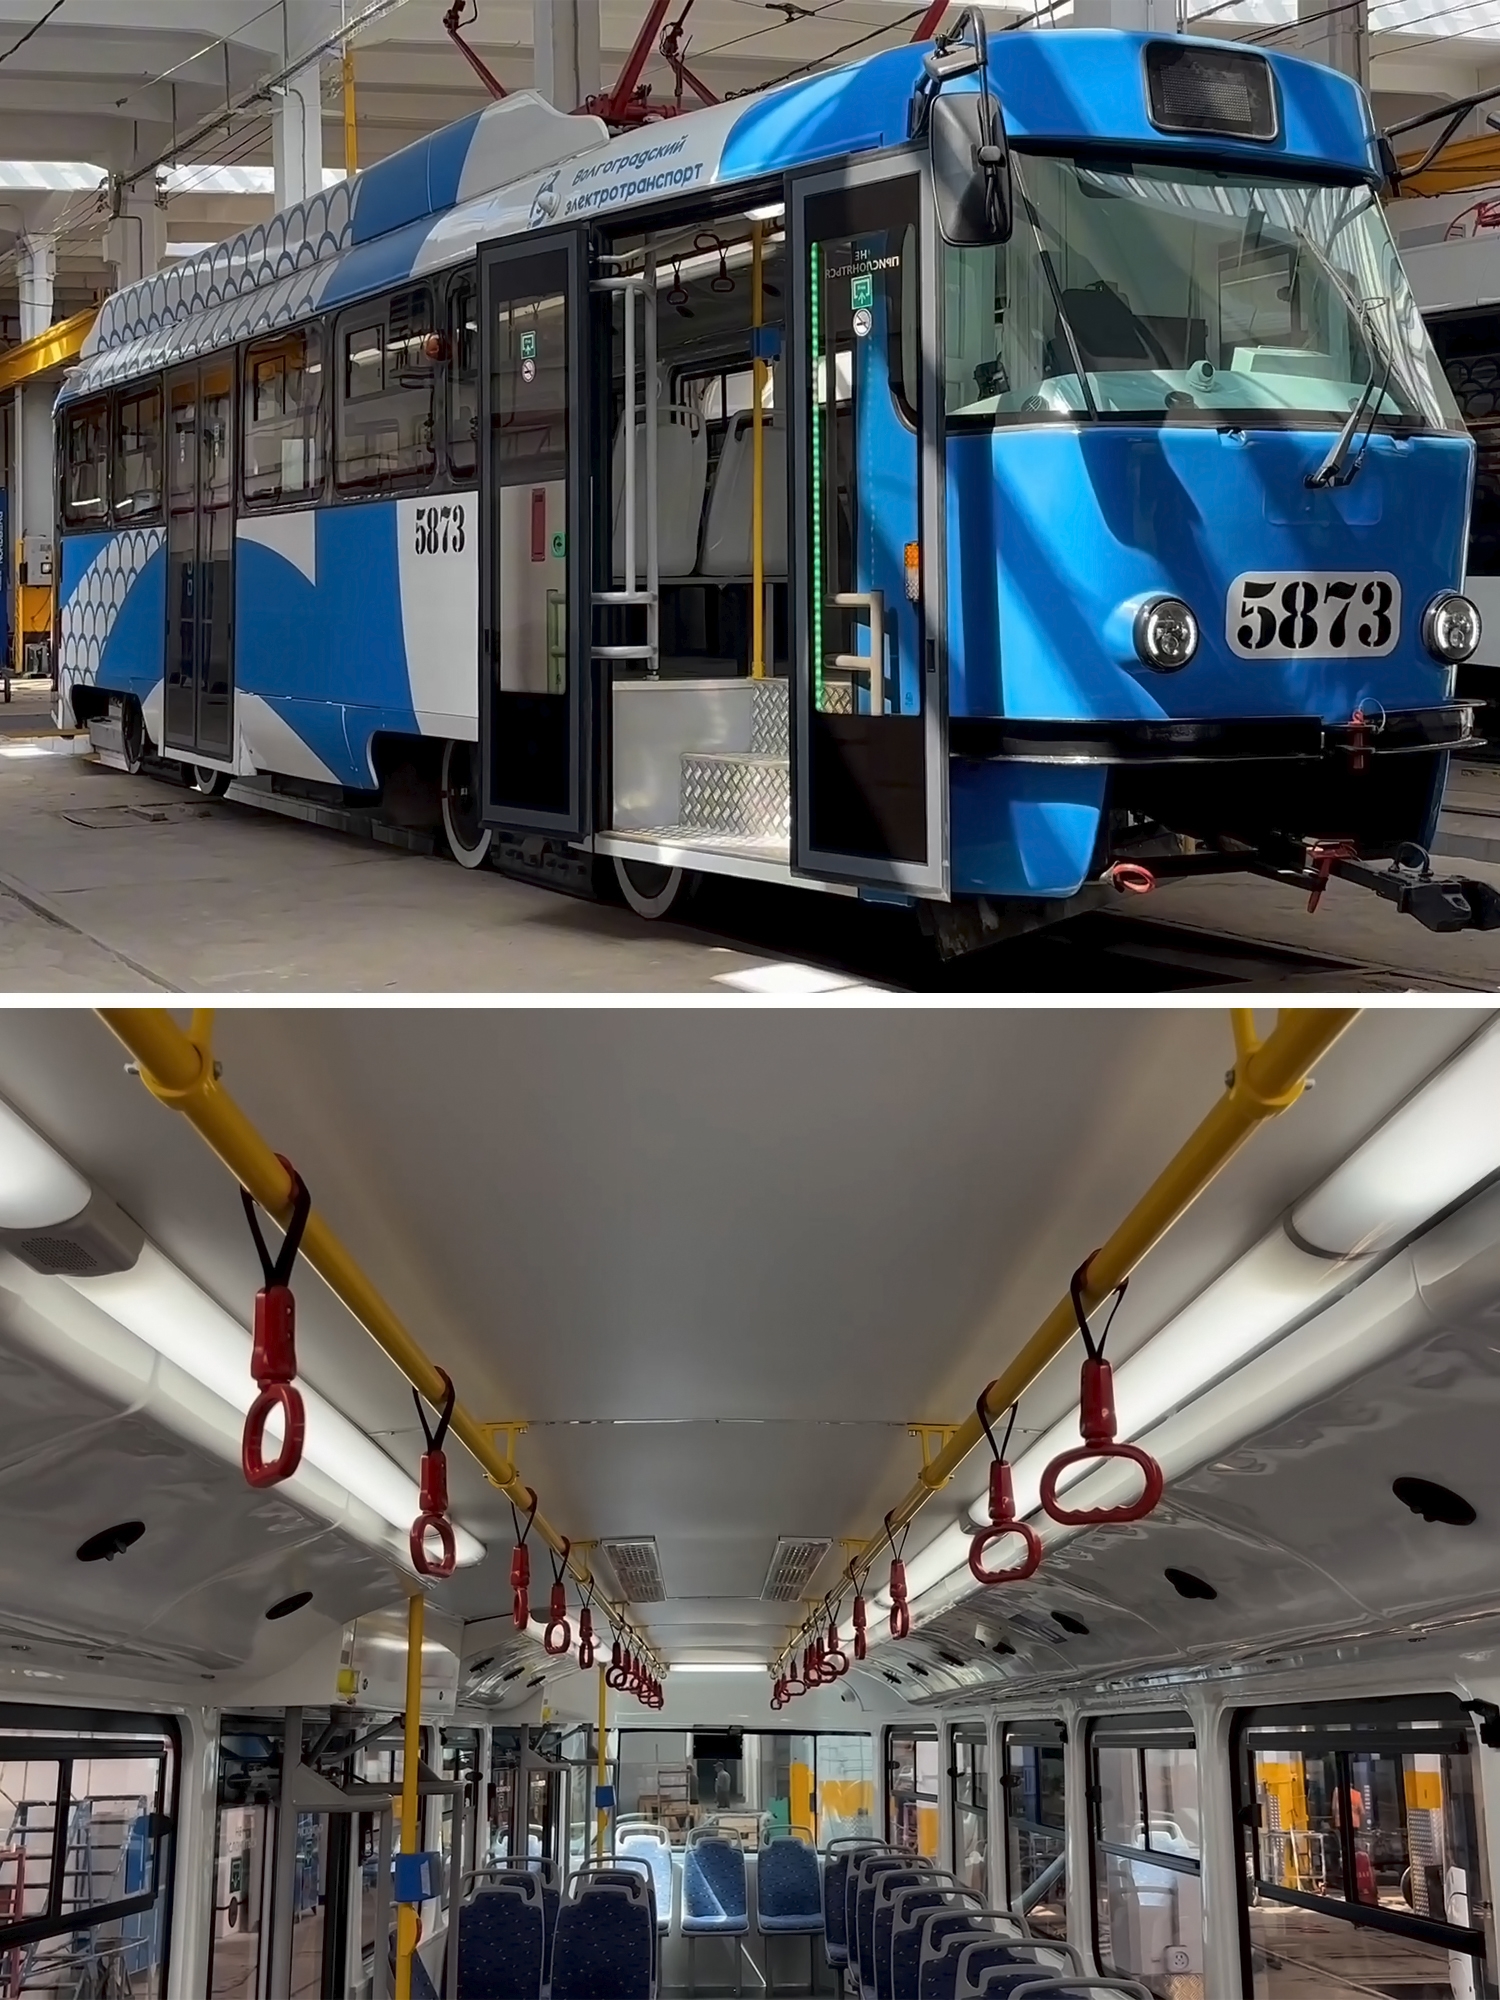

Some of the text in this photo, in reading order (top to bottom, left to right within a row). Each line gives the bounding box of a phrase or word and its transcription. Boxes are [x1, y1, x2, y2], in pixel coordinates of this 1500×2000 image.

[571, 134, 689, 187] Волгоградский
[564, 162, 703, 216] электротранспорт
[415, 504, 466, 554] 5873
[1237, 581, 1393, 650] 5873
